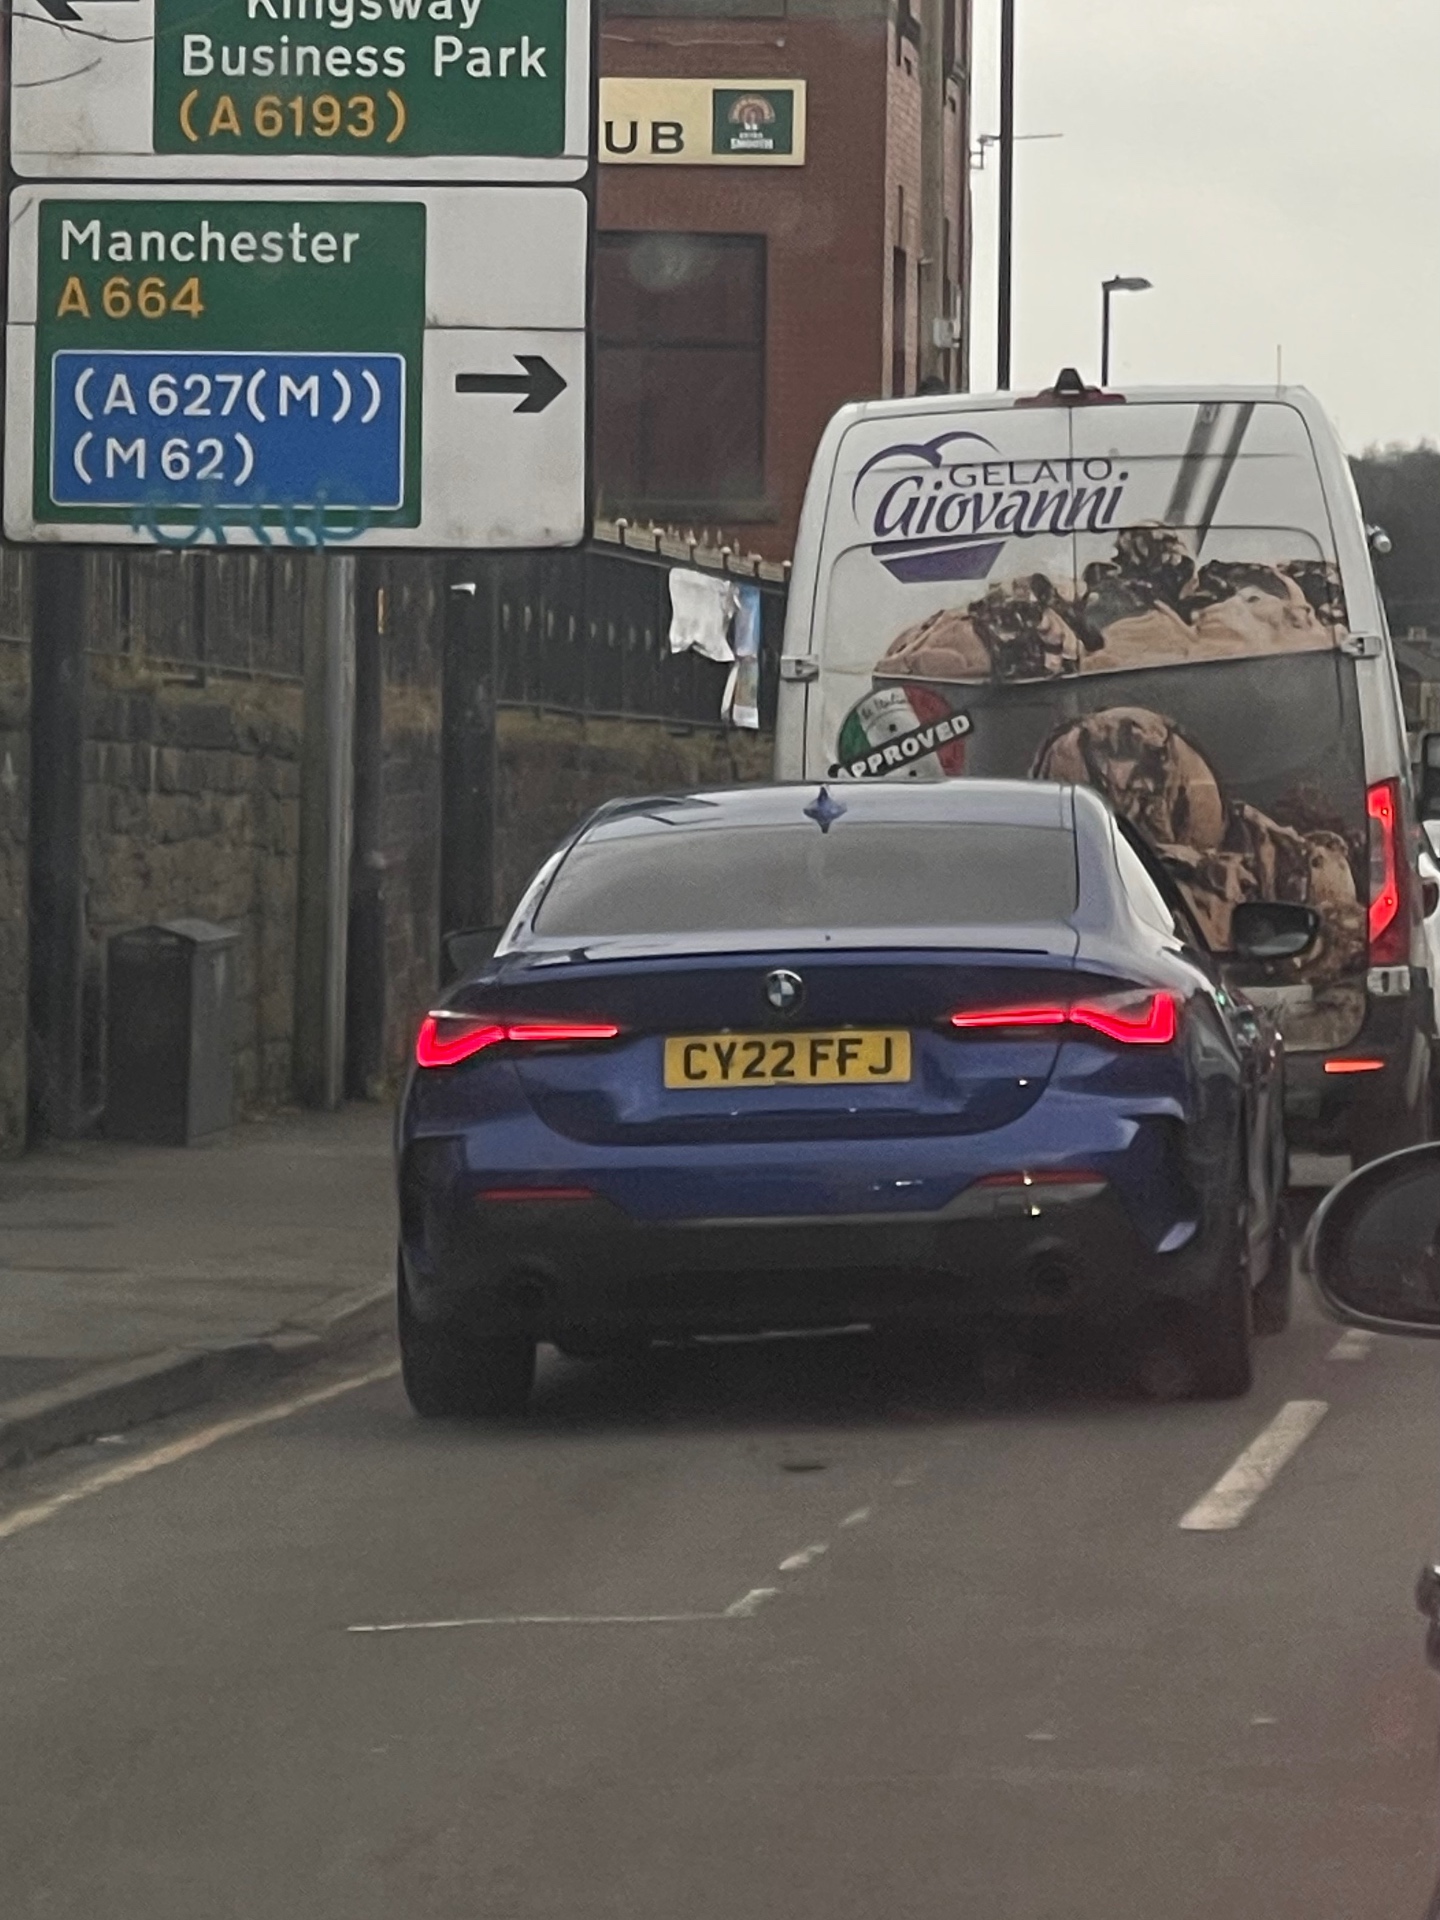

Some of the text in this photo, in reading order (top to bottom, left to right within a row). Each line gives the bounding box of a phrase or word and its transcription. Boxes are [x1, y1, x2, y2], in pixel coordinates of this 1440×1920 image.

[182, 36, 548, 78] Business Park
[604, 120, 685, 154] UB
[61, 220, 360, 264] Manchester
[949, 458, 1113, 488] GELATO
[873, 471, 1129, 538] Giovanni
[684, 1037, 893, 1080] CY22 FFJ
